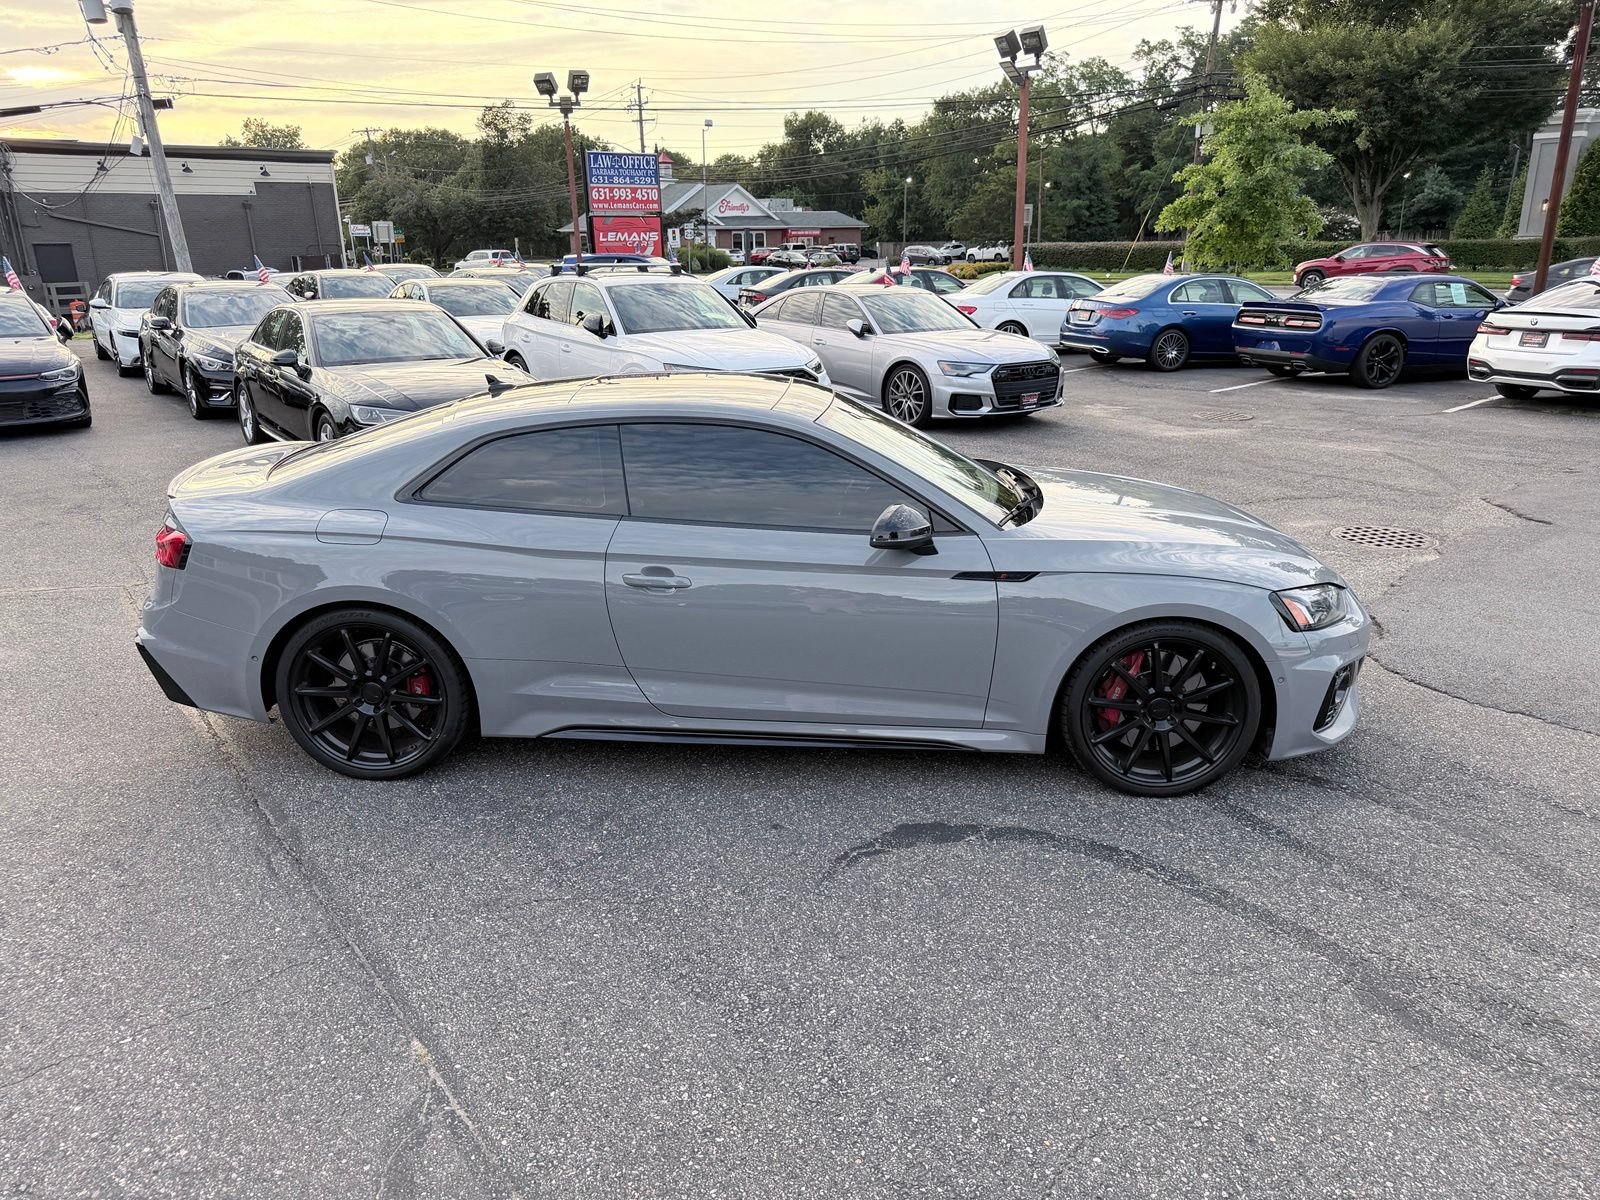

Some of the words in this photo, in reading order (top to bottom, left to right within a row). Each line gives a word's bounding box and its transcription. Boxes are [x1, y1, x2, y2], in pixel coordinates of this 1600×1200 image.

[590, 154, 612, 168] LAW
[621, 155, 656, 170] OFFICE
[592, 176, 656, 184] 631-864-5291
[592, 188, 658, 200] 631-993-4510
[600, 232, 658, 241] LEMANS
